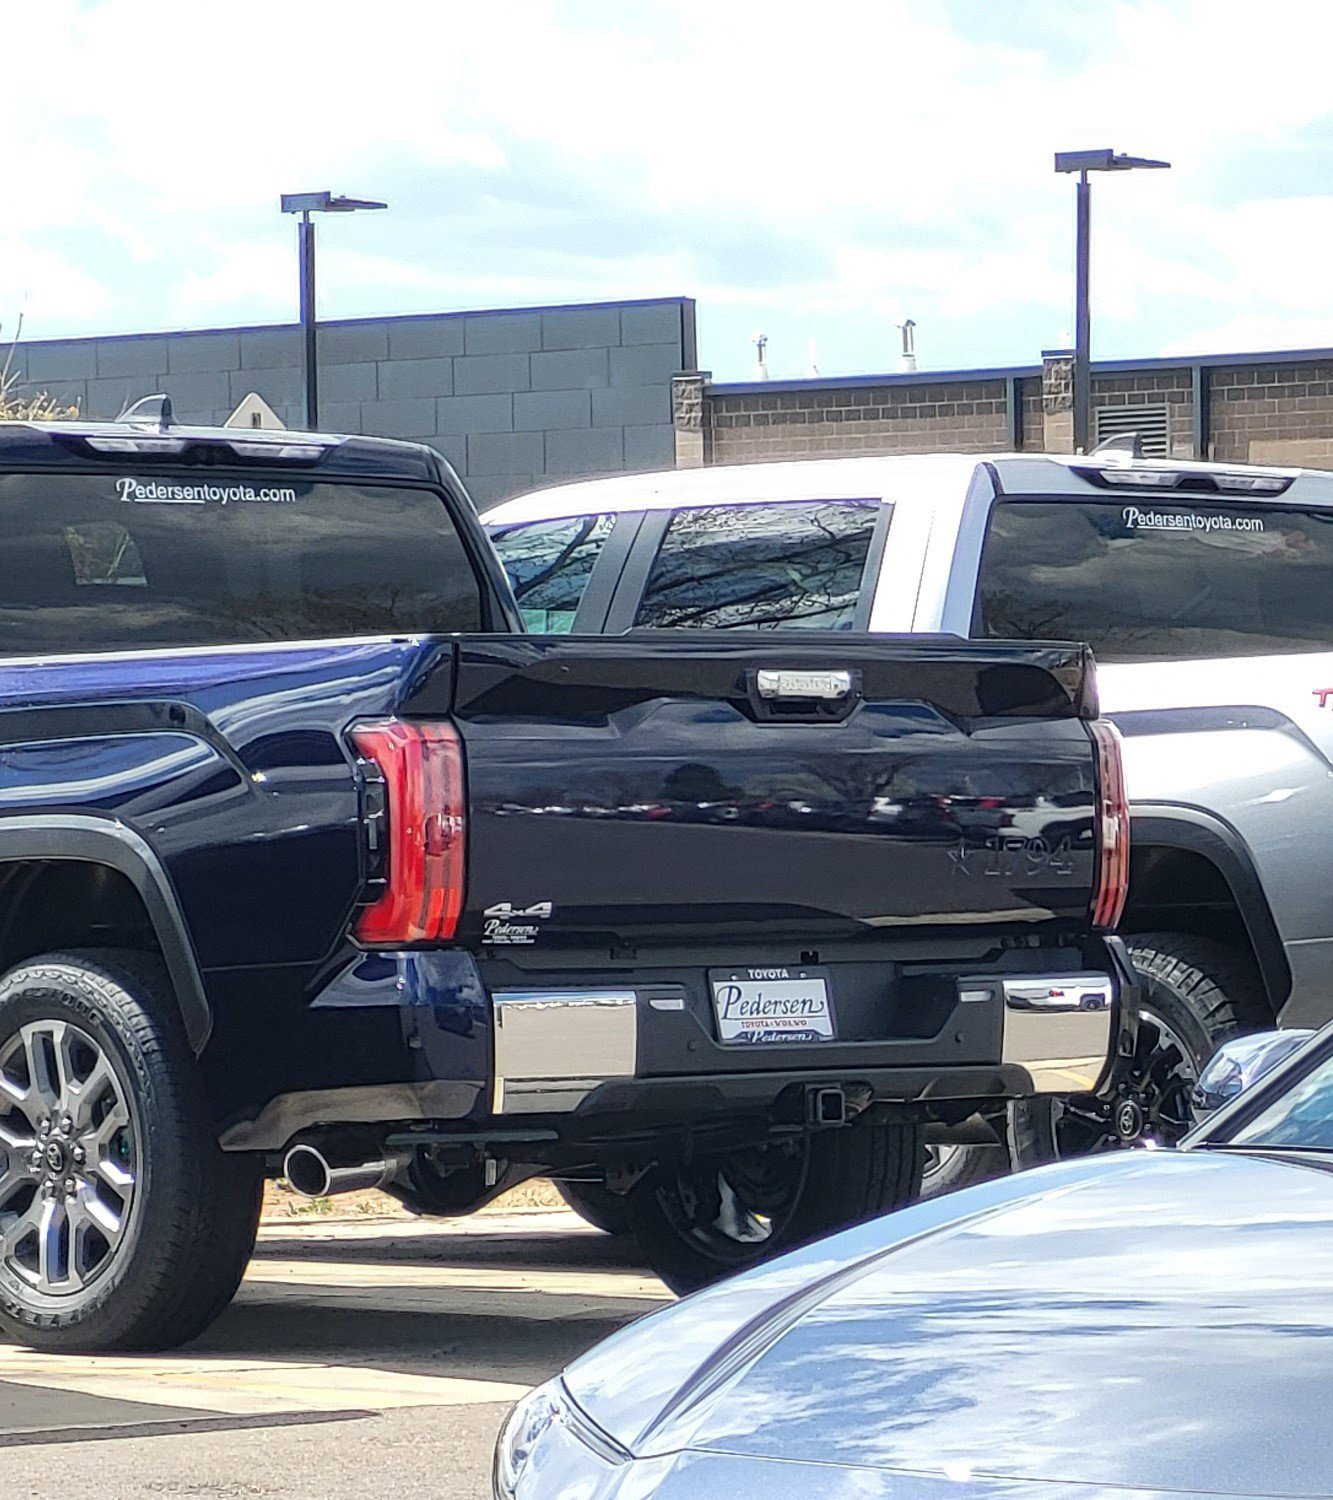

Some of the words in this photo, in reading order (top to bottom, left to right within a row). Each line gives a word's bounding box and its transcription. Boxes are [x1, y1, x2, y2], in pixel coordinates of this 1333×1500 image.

[116, 478, 296, 505] Pedersentoyota.com
[1123, 507, 1264, 532] Pedersentoyota.com
[484, 901, 553, 919] 4x4
[748, 969, 789, 980] TOYOTA
[716, 985, 825, 1020] Pedersen
